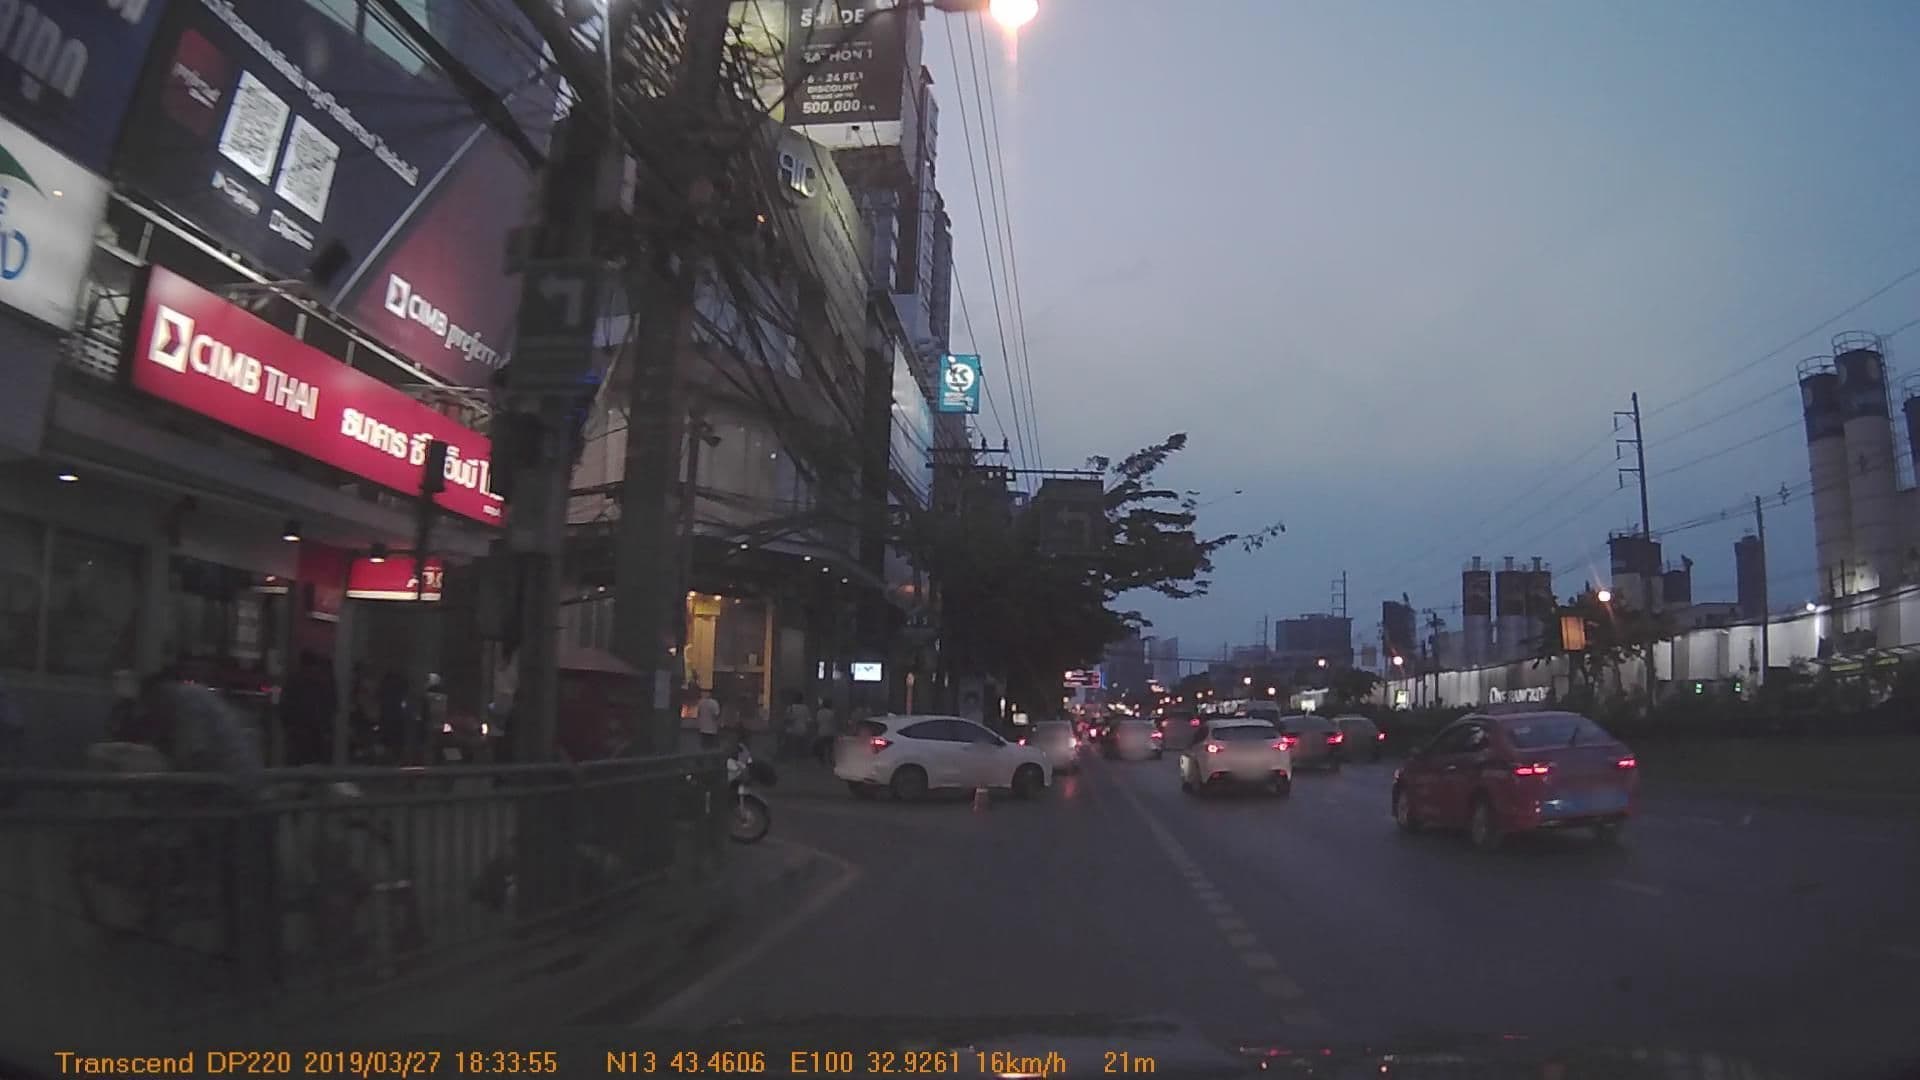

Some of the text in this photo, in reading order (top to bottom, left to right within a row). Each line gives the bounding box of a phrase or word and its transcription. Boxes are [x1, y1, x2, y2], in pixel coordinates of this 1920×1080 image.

[802, 100, 860, 115] 500,000
[408, 293, 449, 337] CIMB
[189, 334, 320, 420] CIMB THAI
